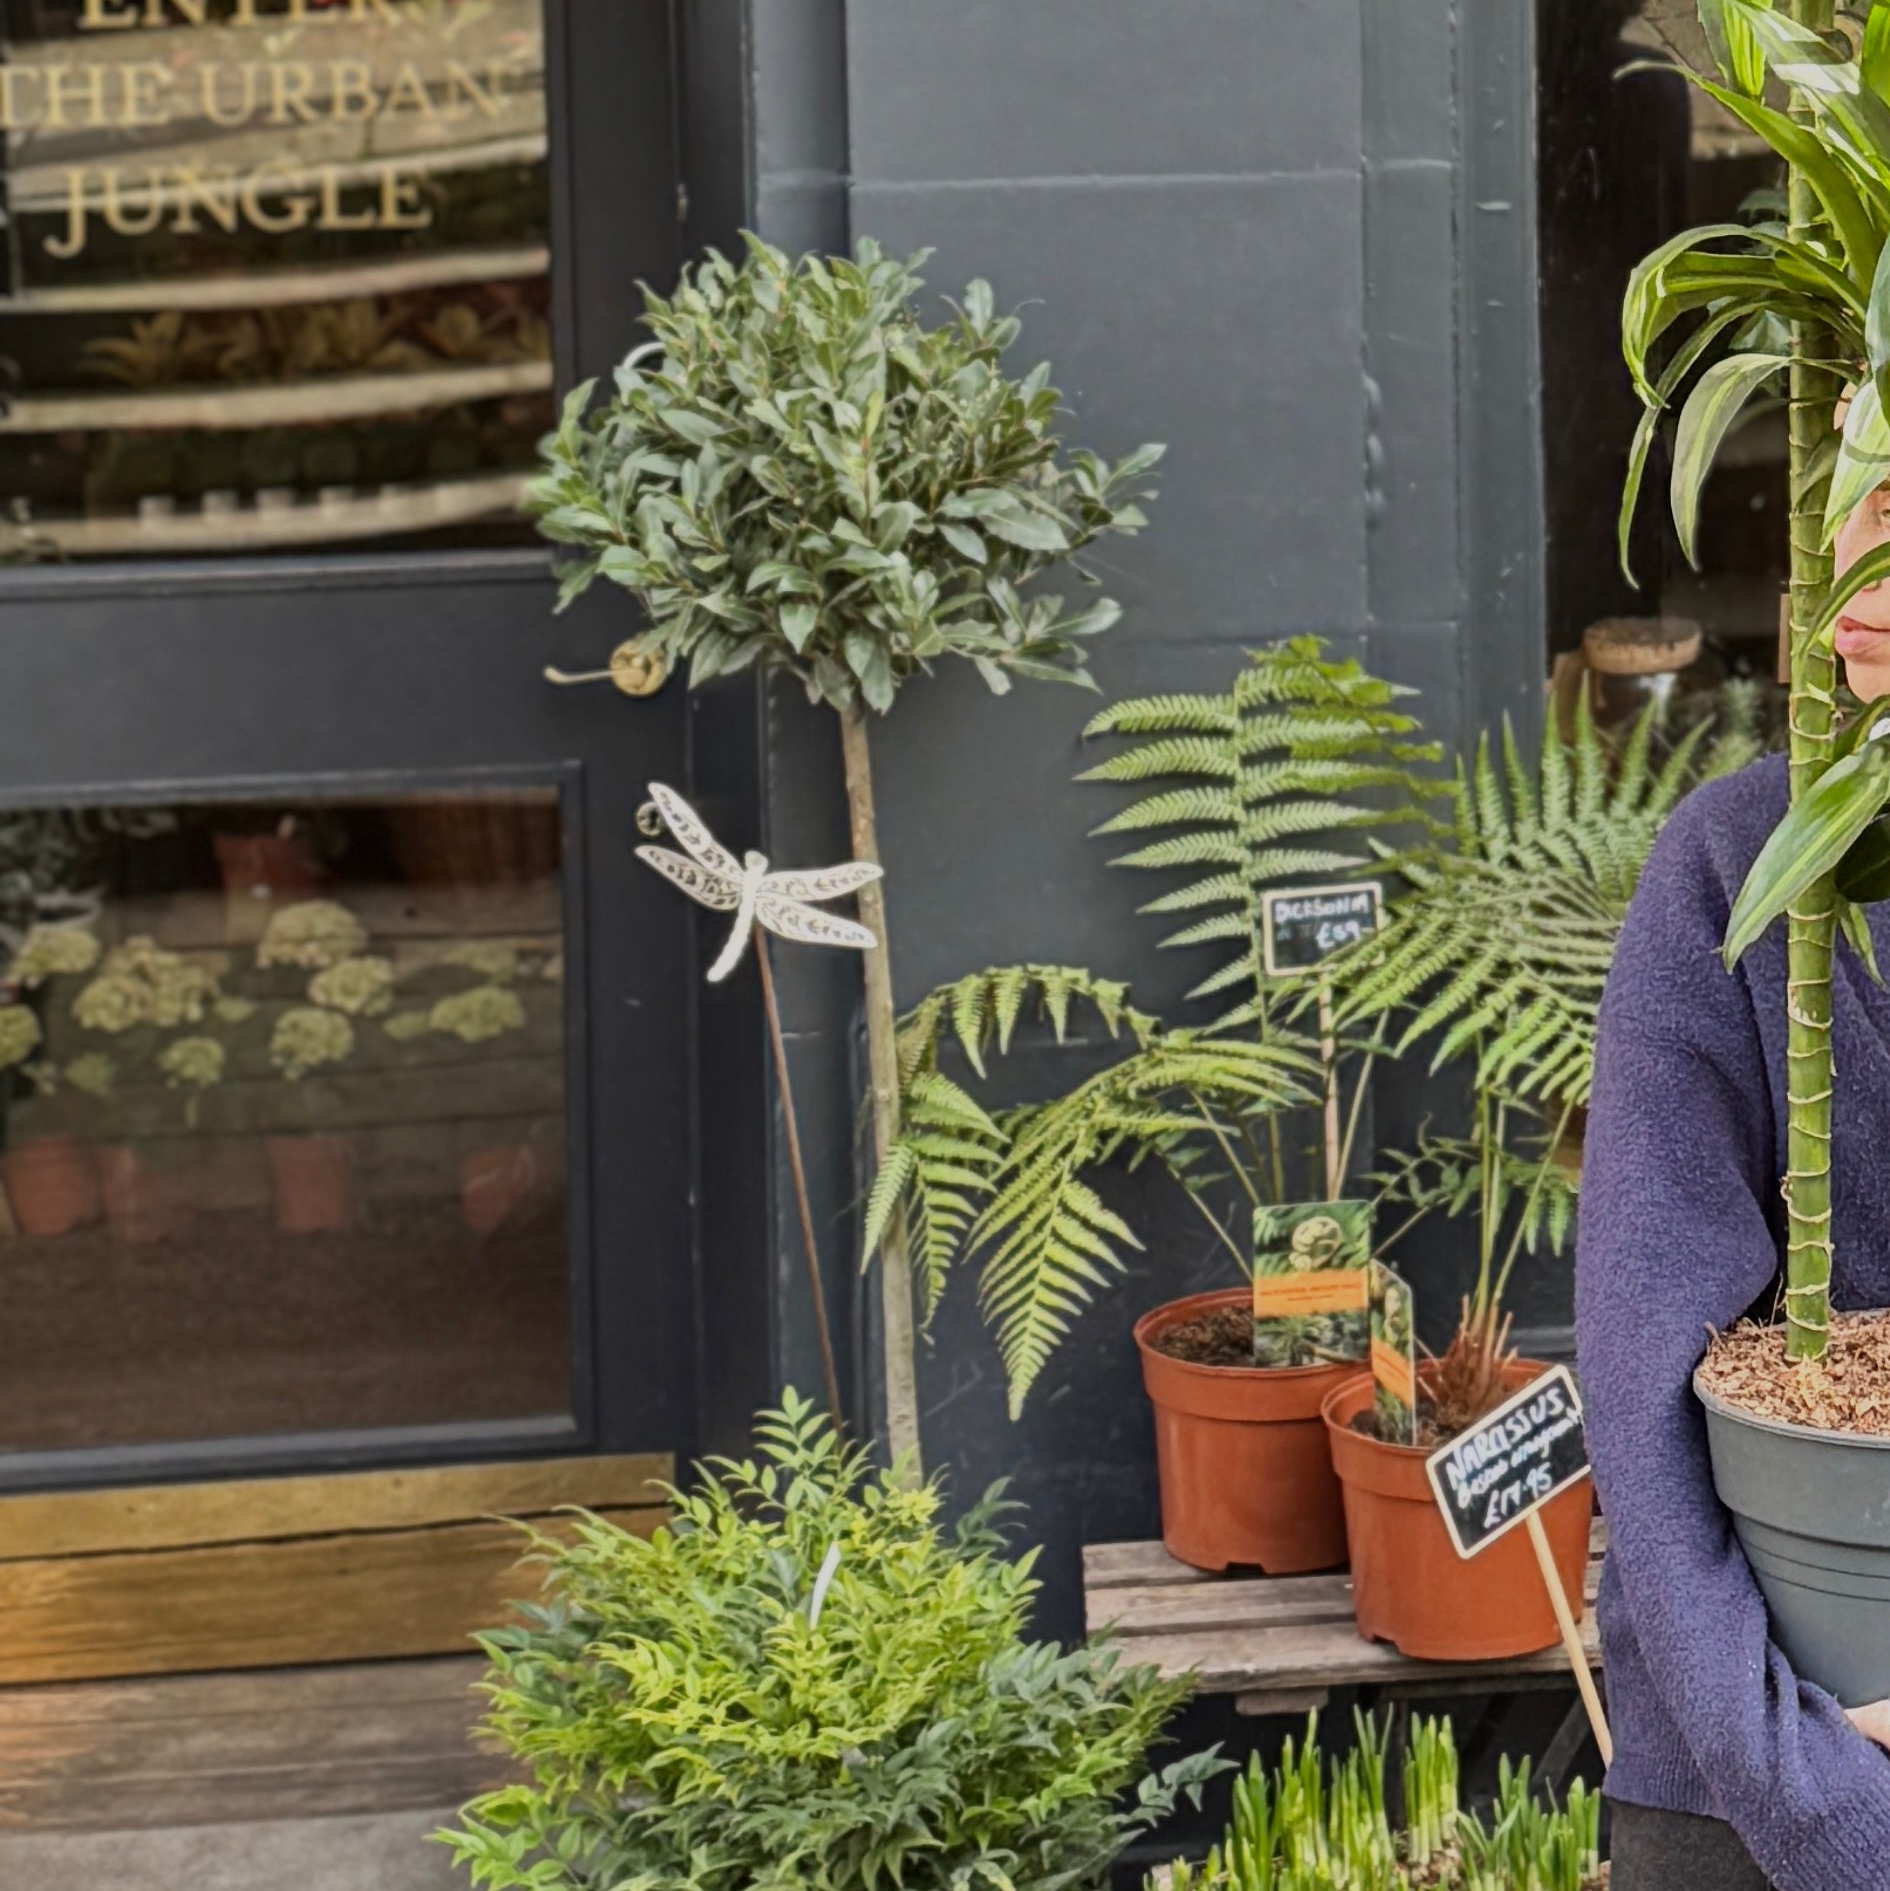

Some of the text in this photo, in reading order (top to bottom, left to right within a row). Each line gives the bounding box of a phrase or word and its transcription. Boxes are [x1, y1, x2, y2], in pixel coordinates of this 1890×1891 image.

[0, 59, 503, 128] THE URBAN
[42, 157, 435, 260] JUNGLE
